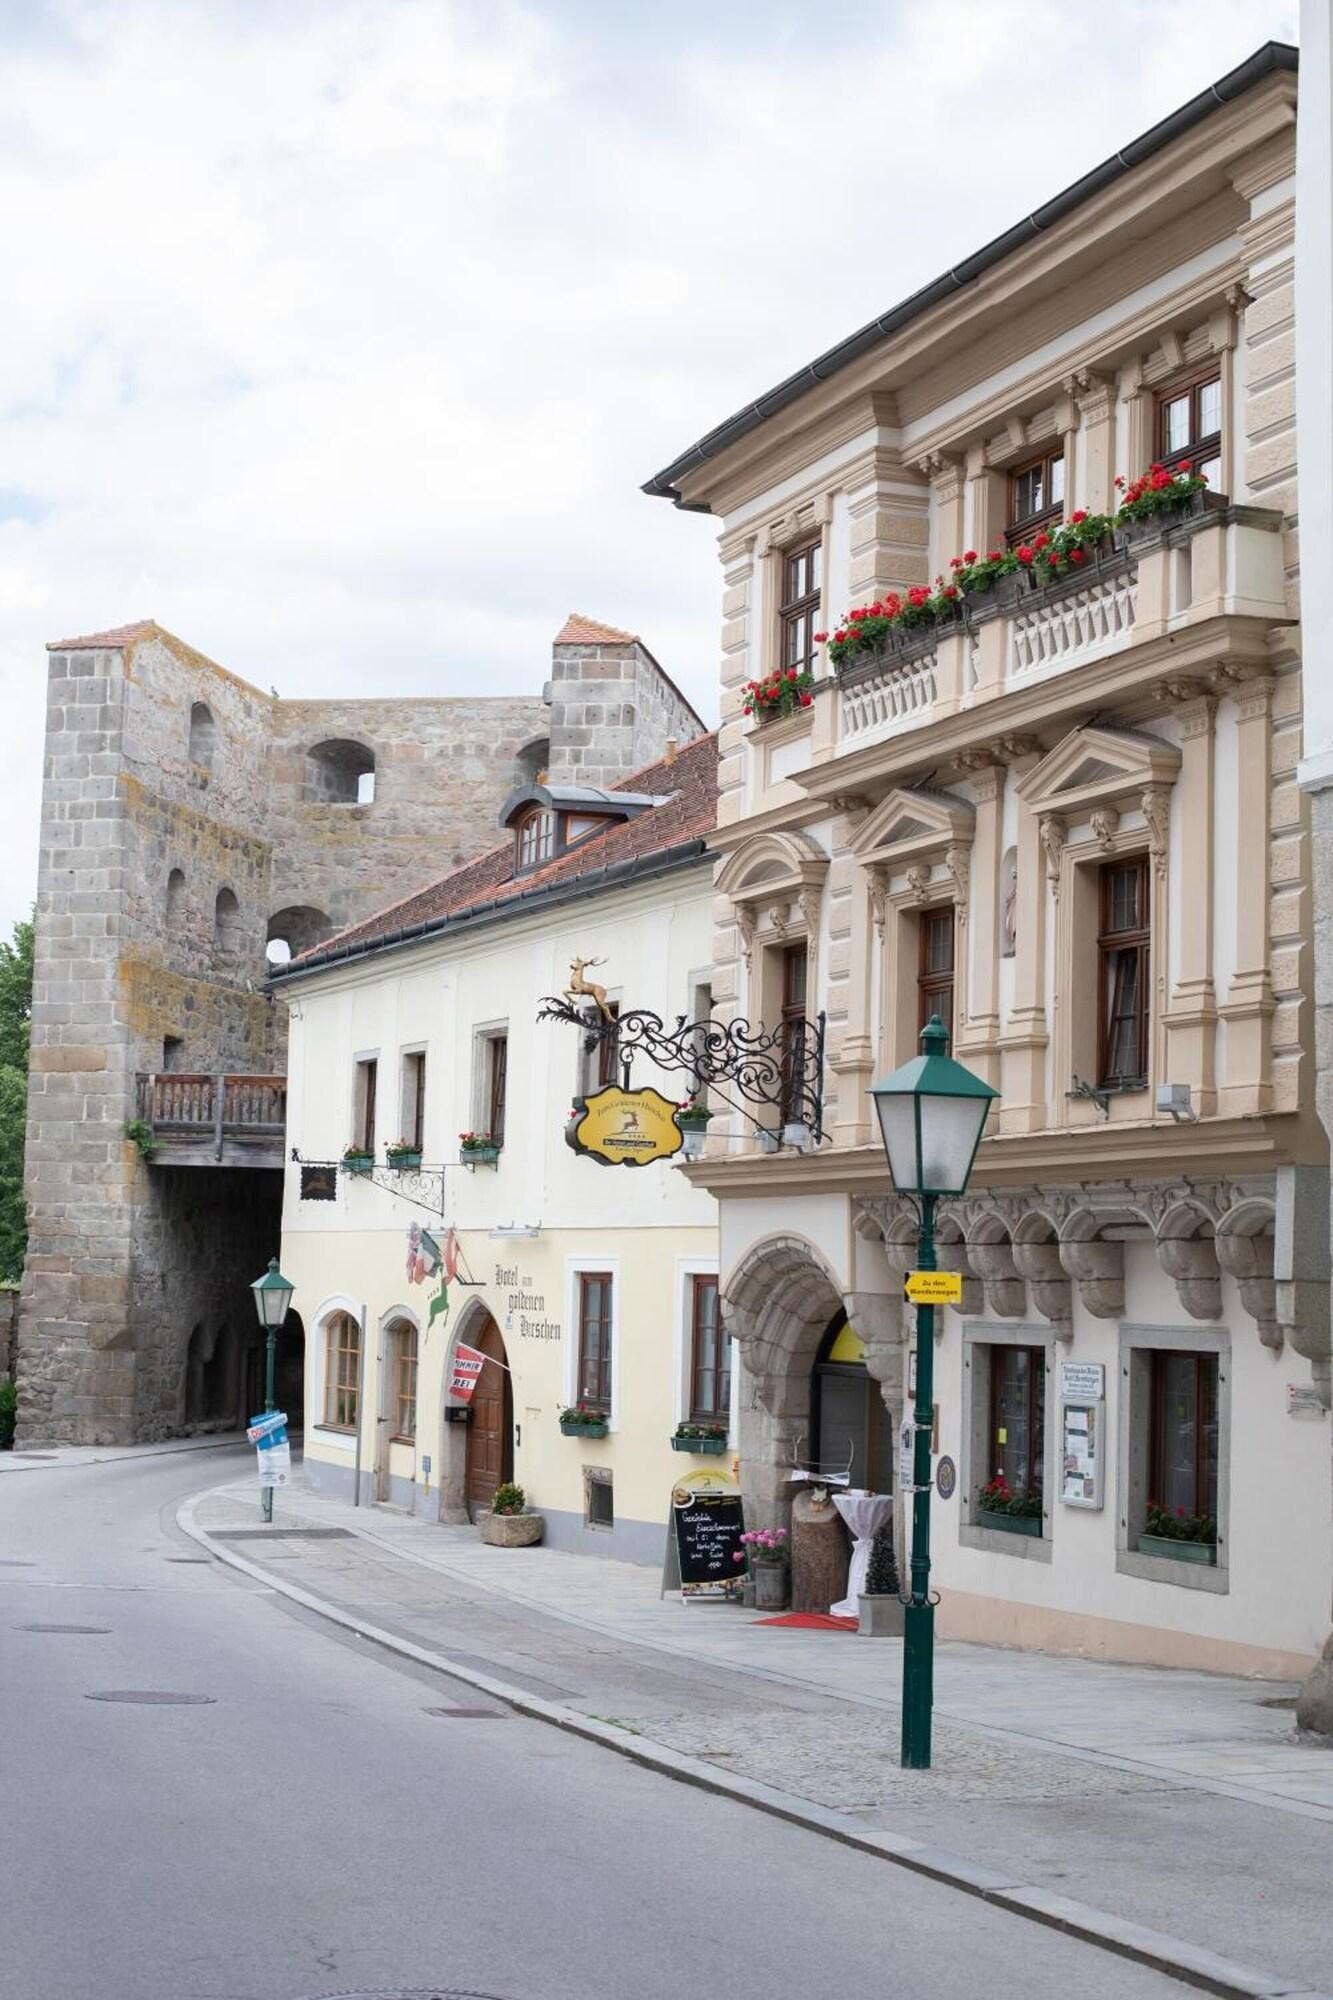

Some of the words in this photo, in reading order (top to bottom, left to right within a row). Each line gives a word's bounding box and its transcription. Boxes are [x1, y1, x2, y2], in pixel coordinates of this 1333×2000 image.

[495, 1264, 519, 1287] Hotel
[508, 1289, 545, 1314] goldenen
[520, 1314, 561, 1341] Hirschen
